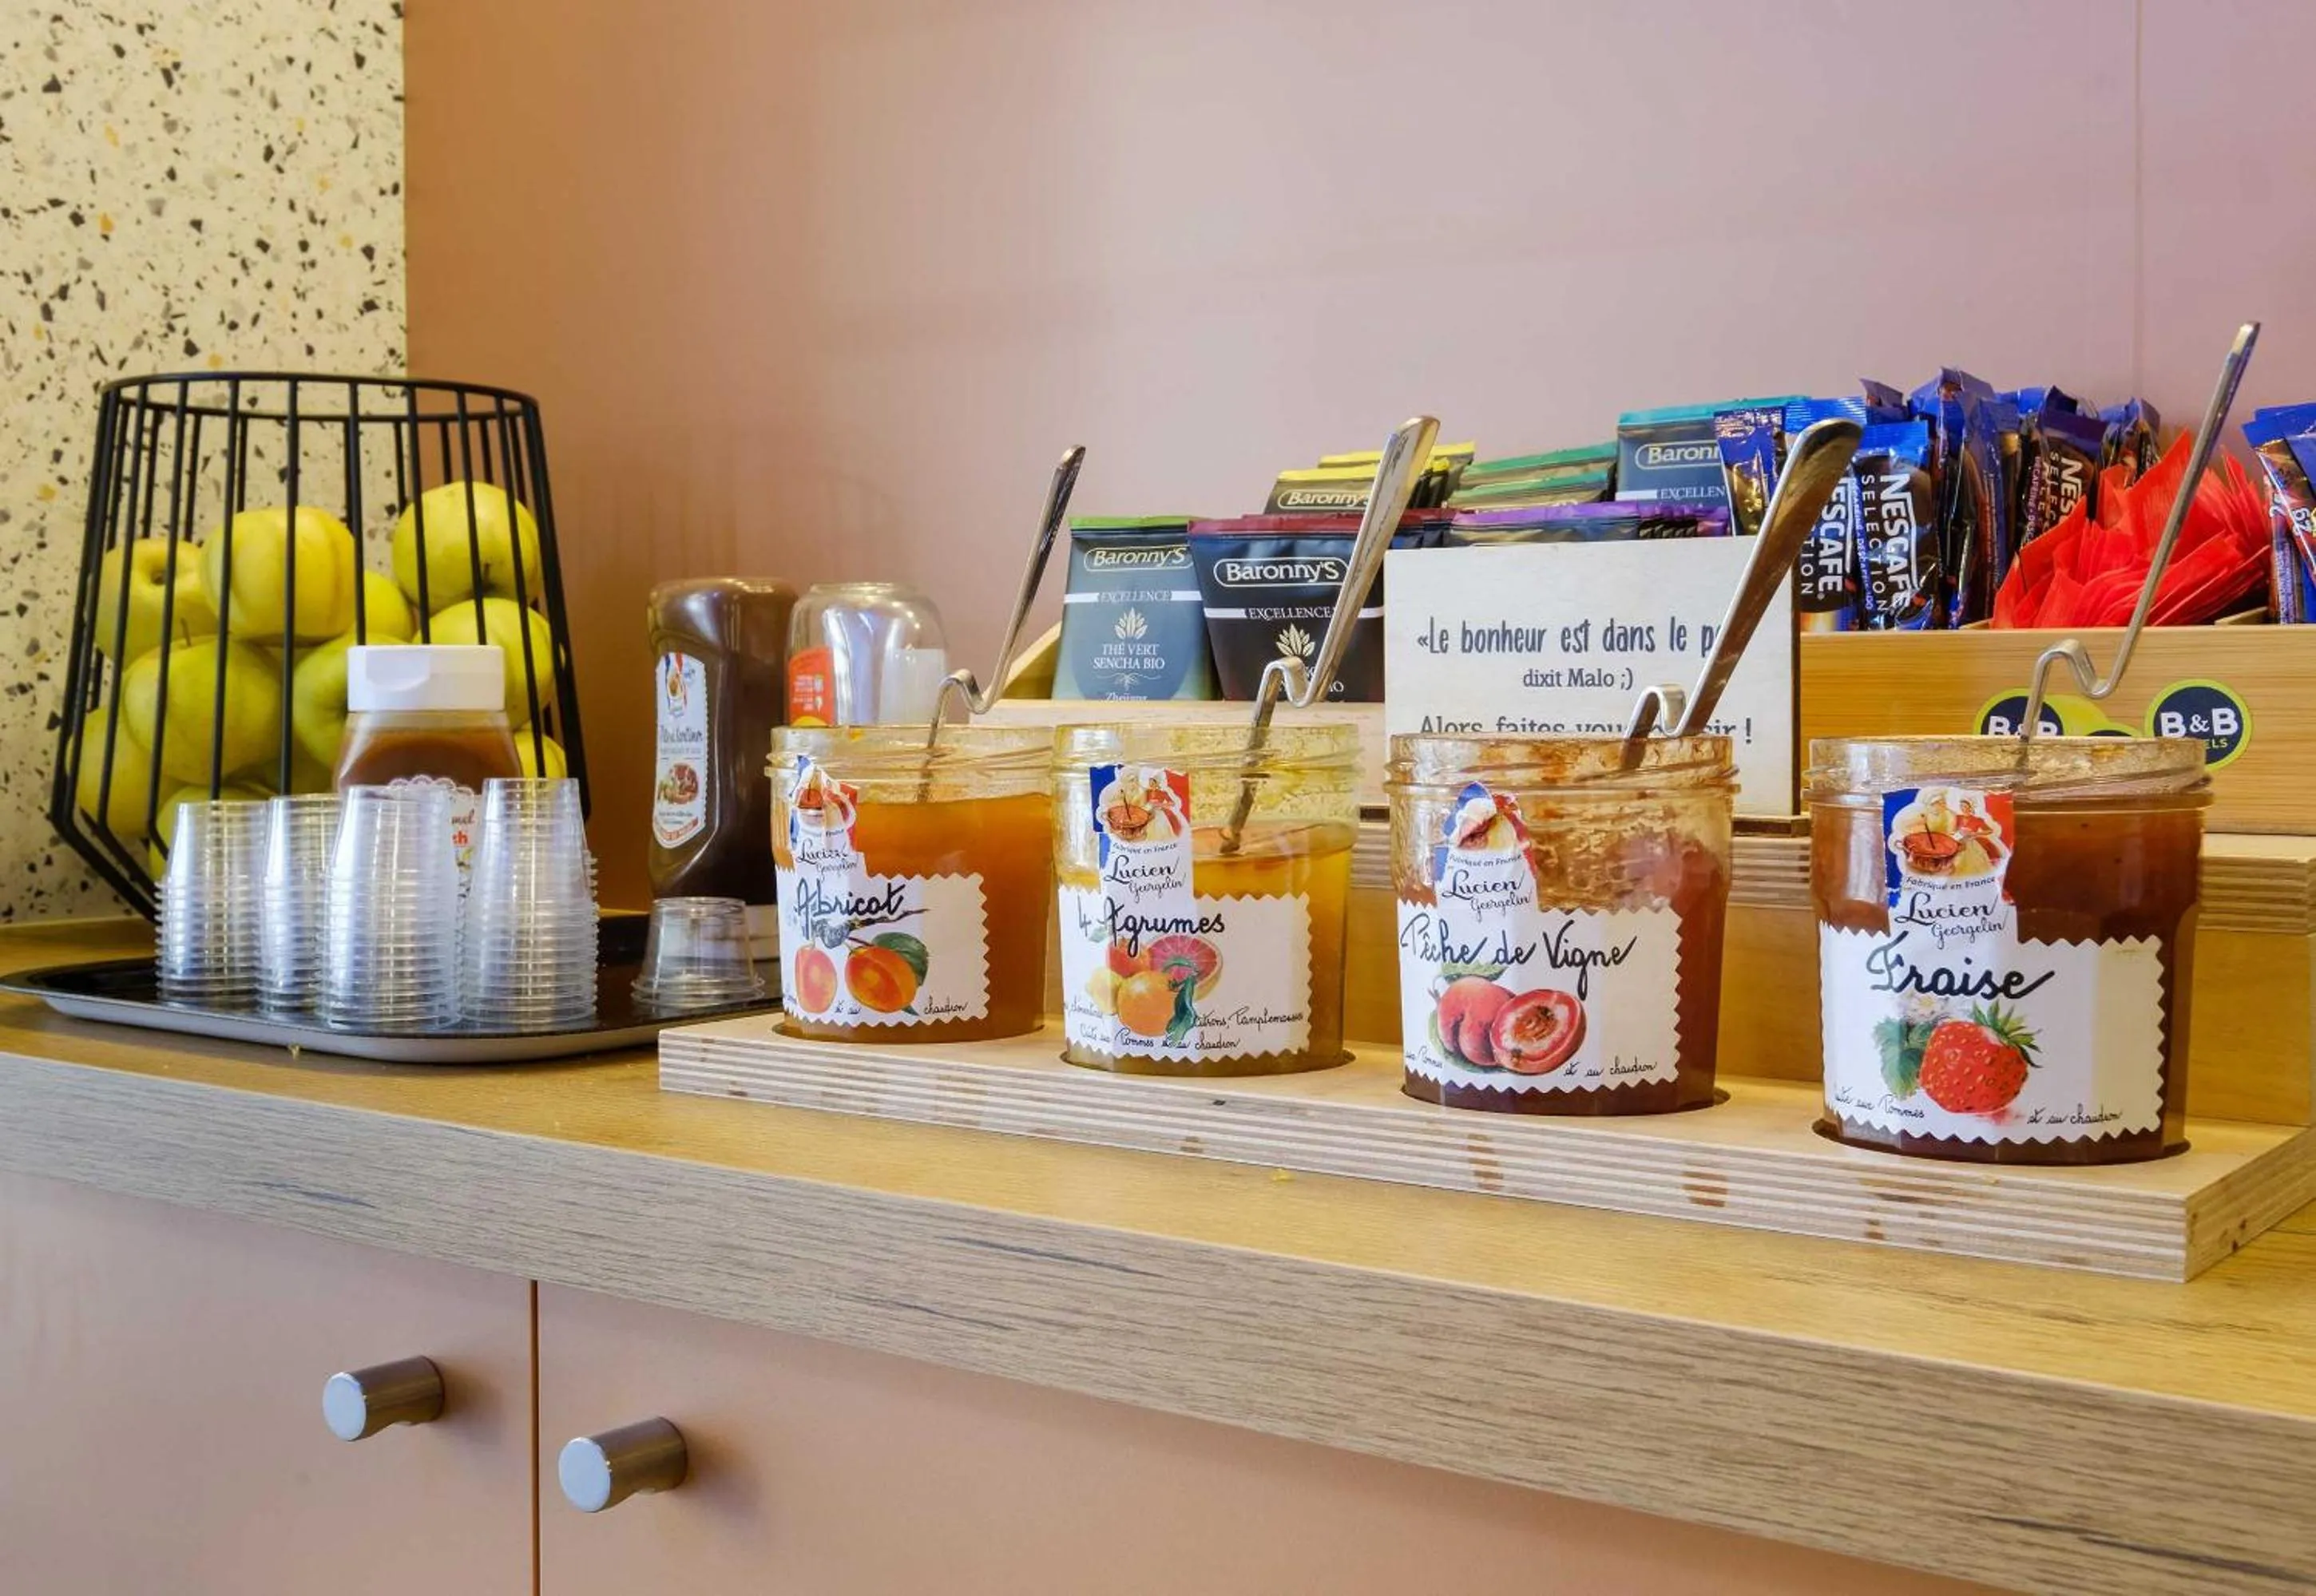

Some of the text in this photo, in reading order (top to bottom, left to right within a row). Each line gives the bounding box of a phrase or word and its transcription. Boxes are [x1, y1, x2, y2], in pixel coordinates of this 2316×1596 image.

[1647, 445, 1719, 464] Baron
[1660, 485, 1725, 499] EXCELLEN
[1862, 473, 1887, 611] SELECTION
[1099, 591, 1171, 603] EXCELLENCE
[1248, 606, 1333, 620] EXCELLENCE
[1127, 644, 1160, 655] VERT
[1461, 620, 1547, 654] bonheur
[1561, 619, 1590, 653] est
[1602, 617, 1656, 652] dans
[1669, 616, 1687, 651] le
[1093, 657, 1165, 669] SENCHA BIO
[1523, 667, 1563, 688] dixit
[1566, 668, 1615, 688] Malo
[2160, 707, 2239, 739] B&B
[1104, 854, 1180, 885] Lucien
[1442, 869, 1525, 901] Lucien
[793, 876, 906, 941] Abricot
[1894, 891, 1999, 927] Lucien
[1097, 896, 1226, 959] Agrumes
[1931, 909, 2009, 950] Georgelin
[1400, 912, 1638, 1001] Pêche de Vigne
[1865, 929, 2056, 1000] Fraise
